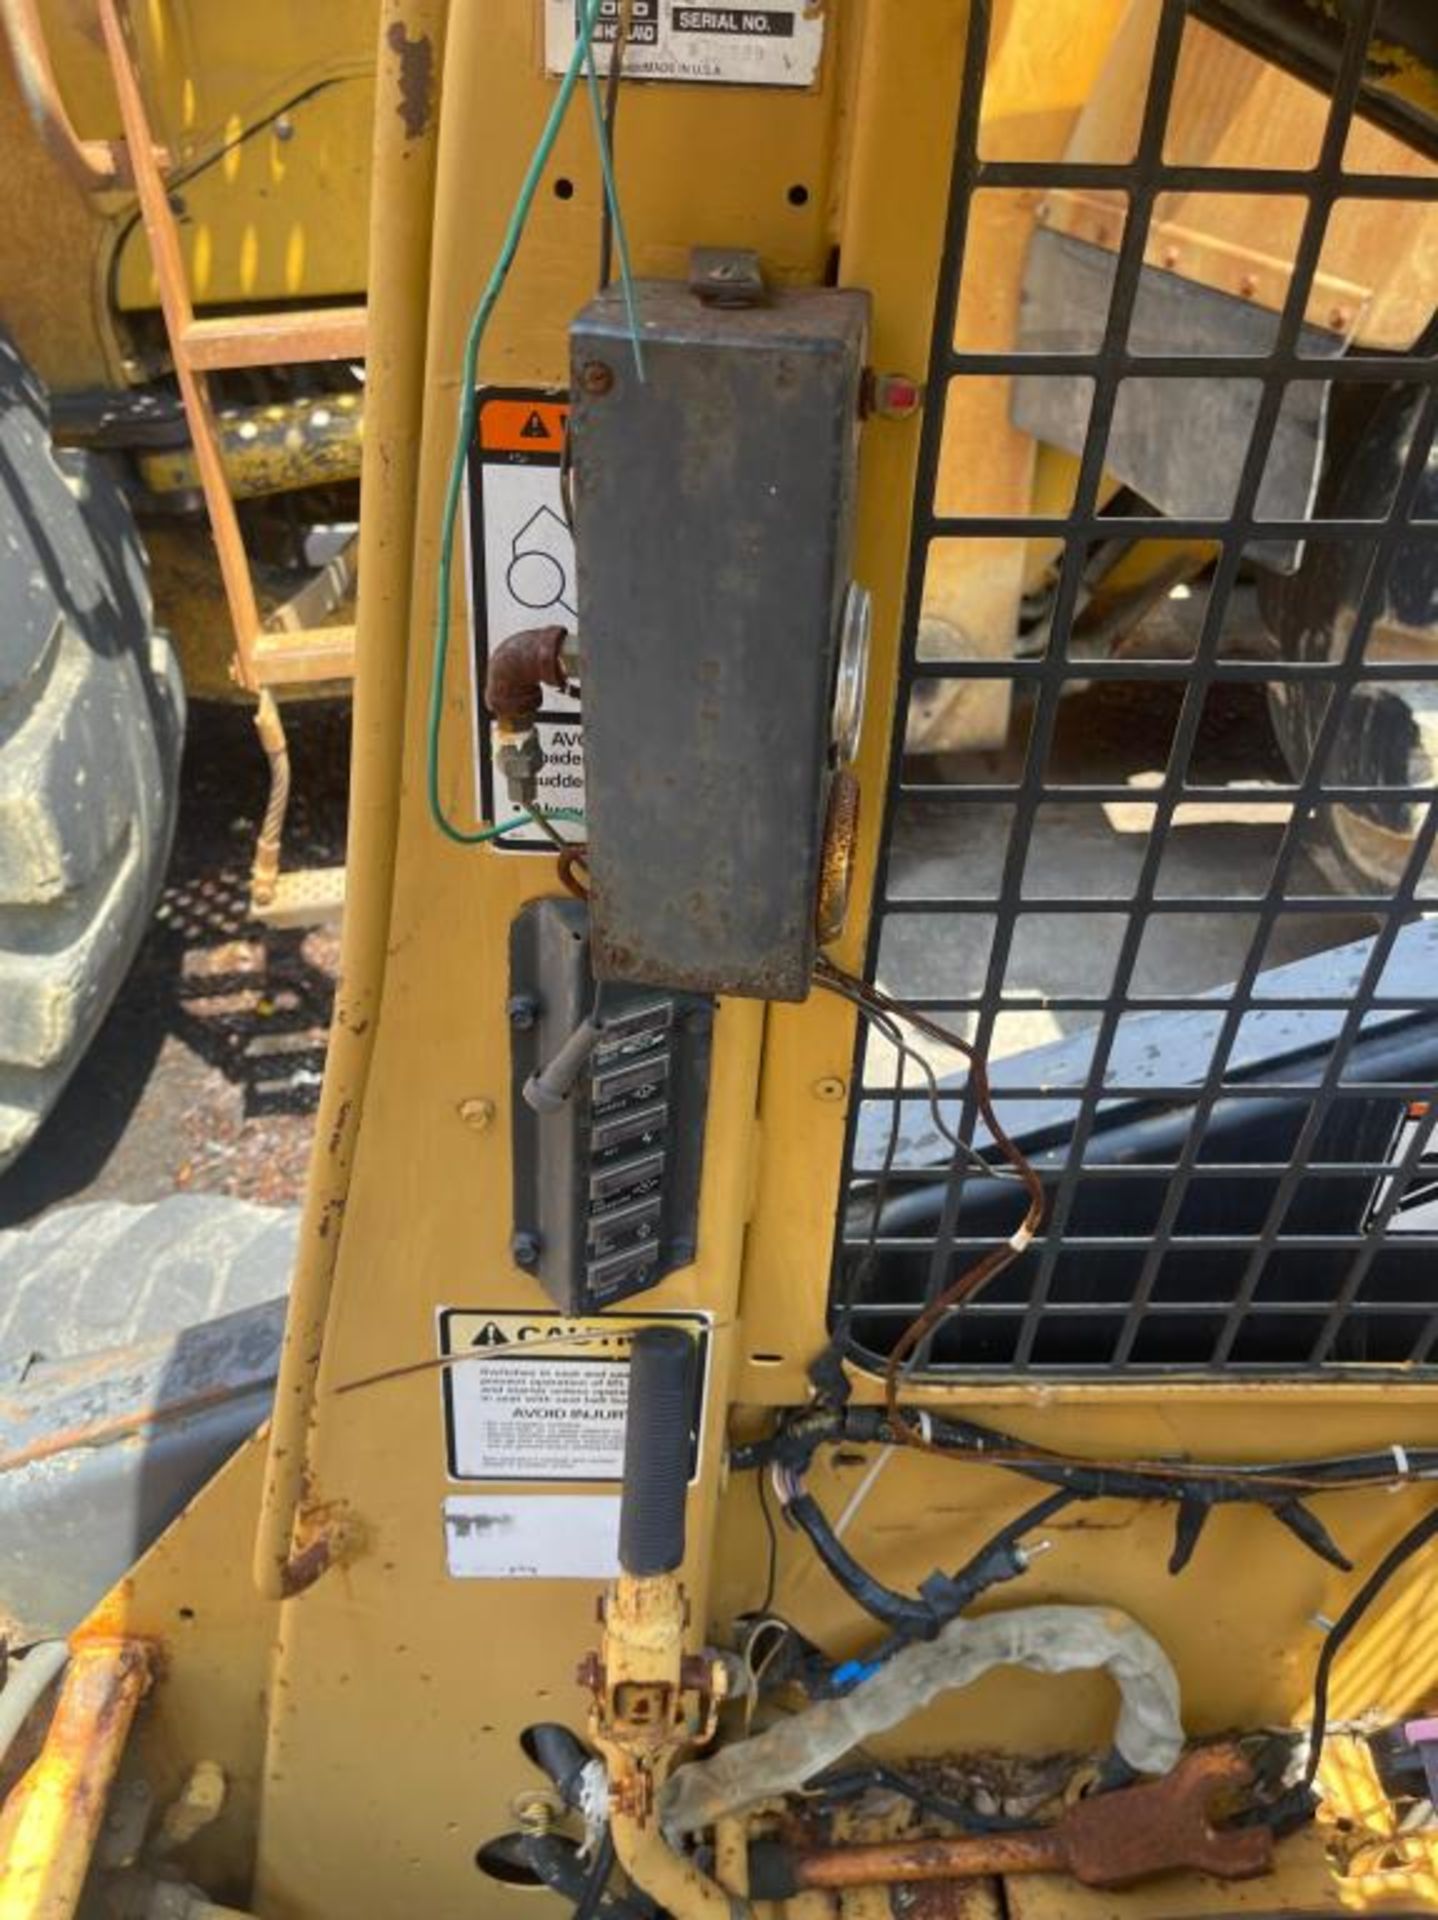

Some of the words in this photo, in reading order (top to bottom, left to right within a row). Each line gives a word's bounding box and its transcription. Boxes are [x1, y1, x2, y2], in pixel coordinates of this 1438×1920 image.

[680, 12, 738, 31] SERIAL
[742, 14, 771, 32] NO.
[512, 1407, 567, 1419] AVOID
[570, 1408, 625, 1420] INJUR
